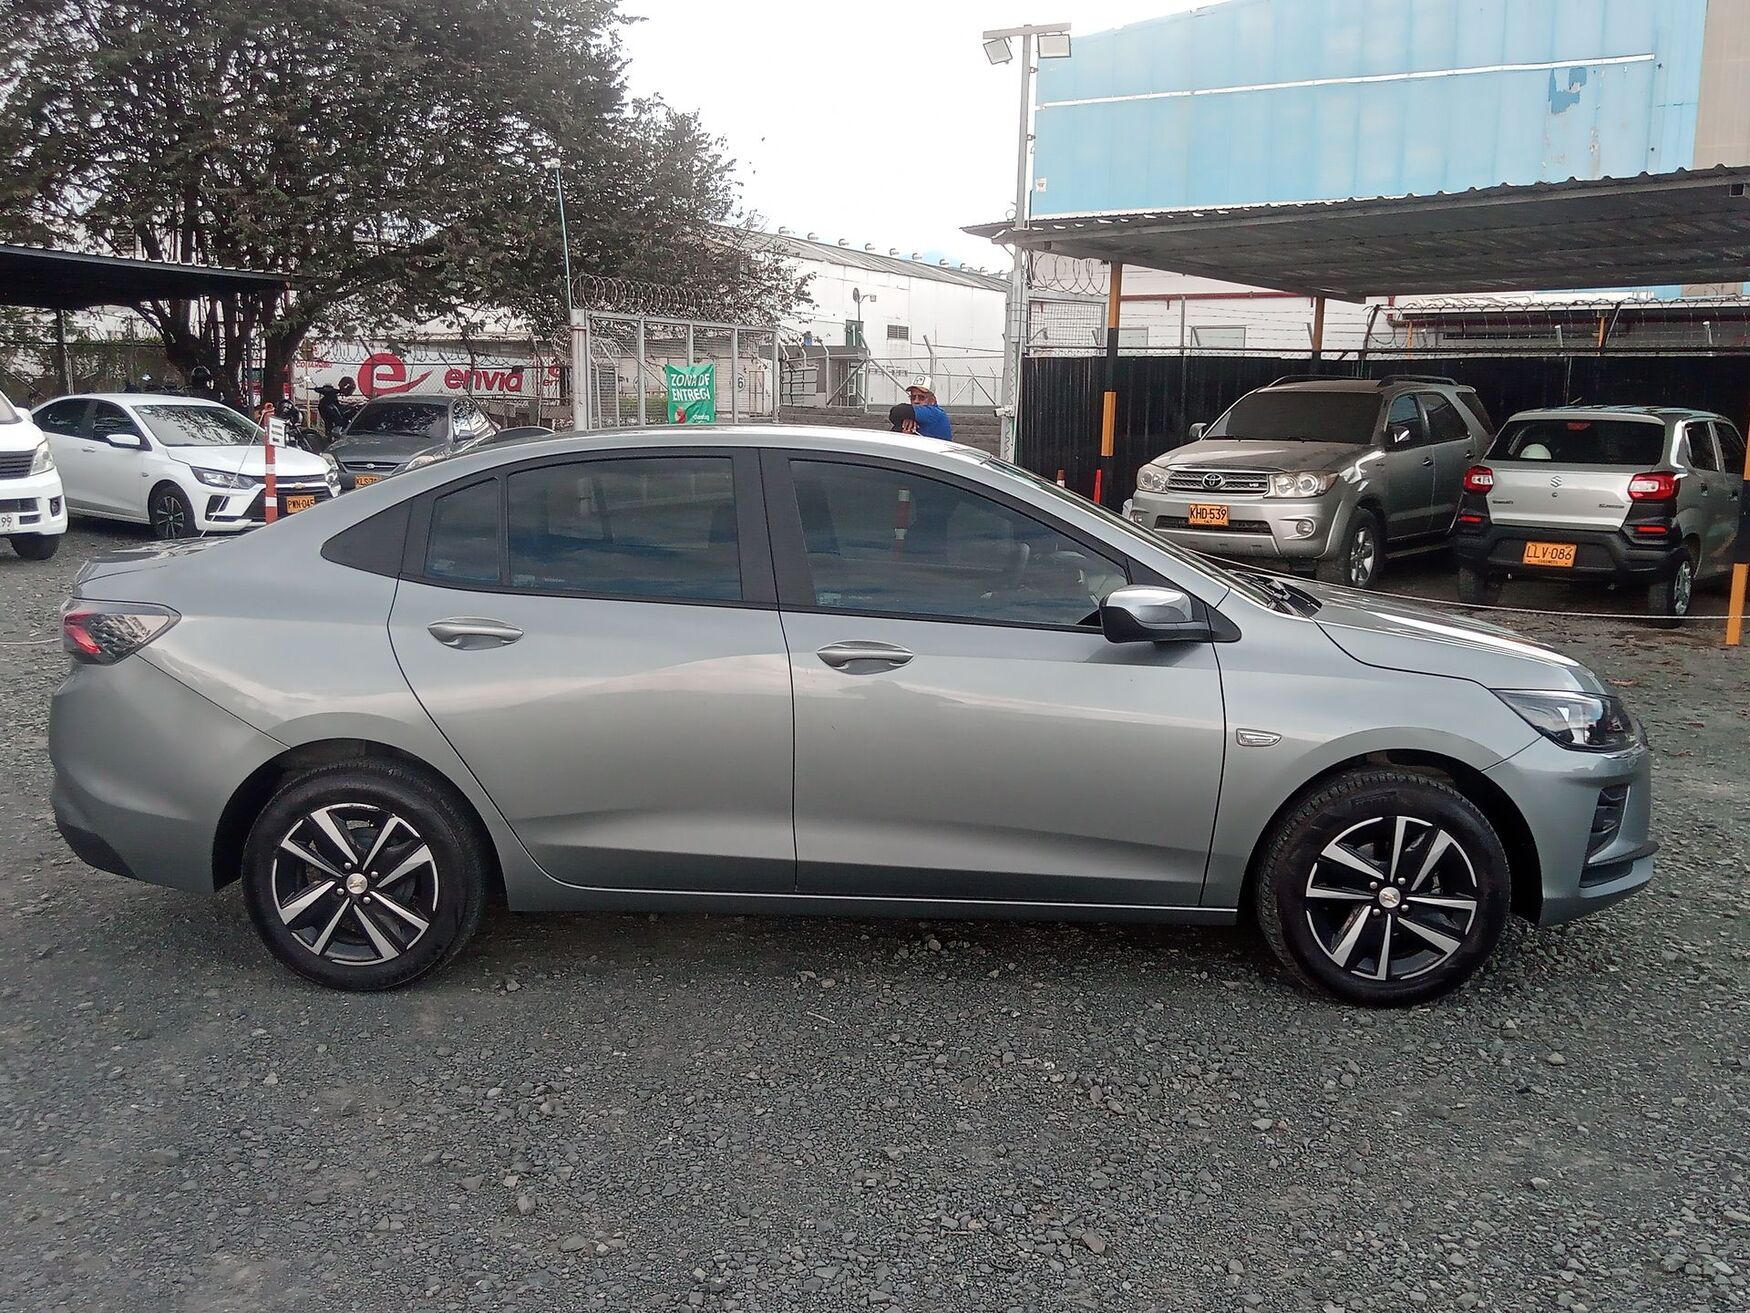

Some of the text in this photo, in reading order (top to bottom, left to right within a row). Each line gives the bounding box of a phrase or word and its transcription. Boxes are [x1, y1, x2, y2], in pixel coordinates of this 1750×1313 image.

[670, 373, 698, 387] ZONA
[1190, 507, 1227, 520] KHD-539
[1526, 545, 1573, 560] LLV-086
